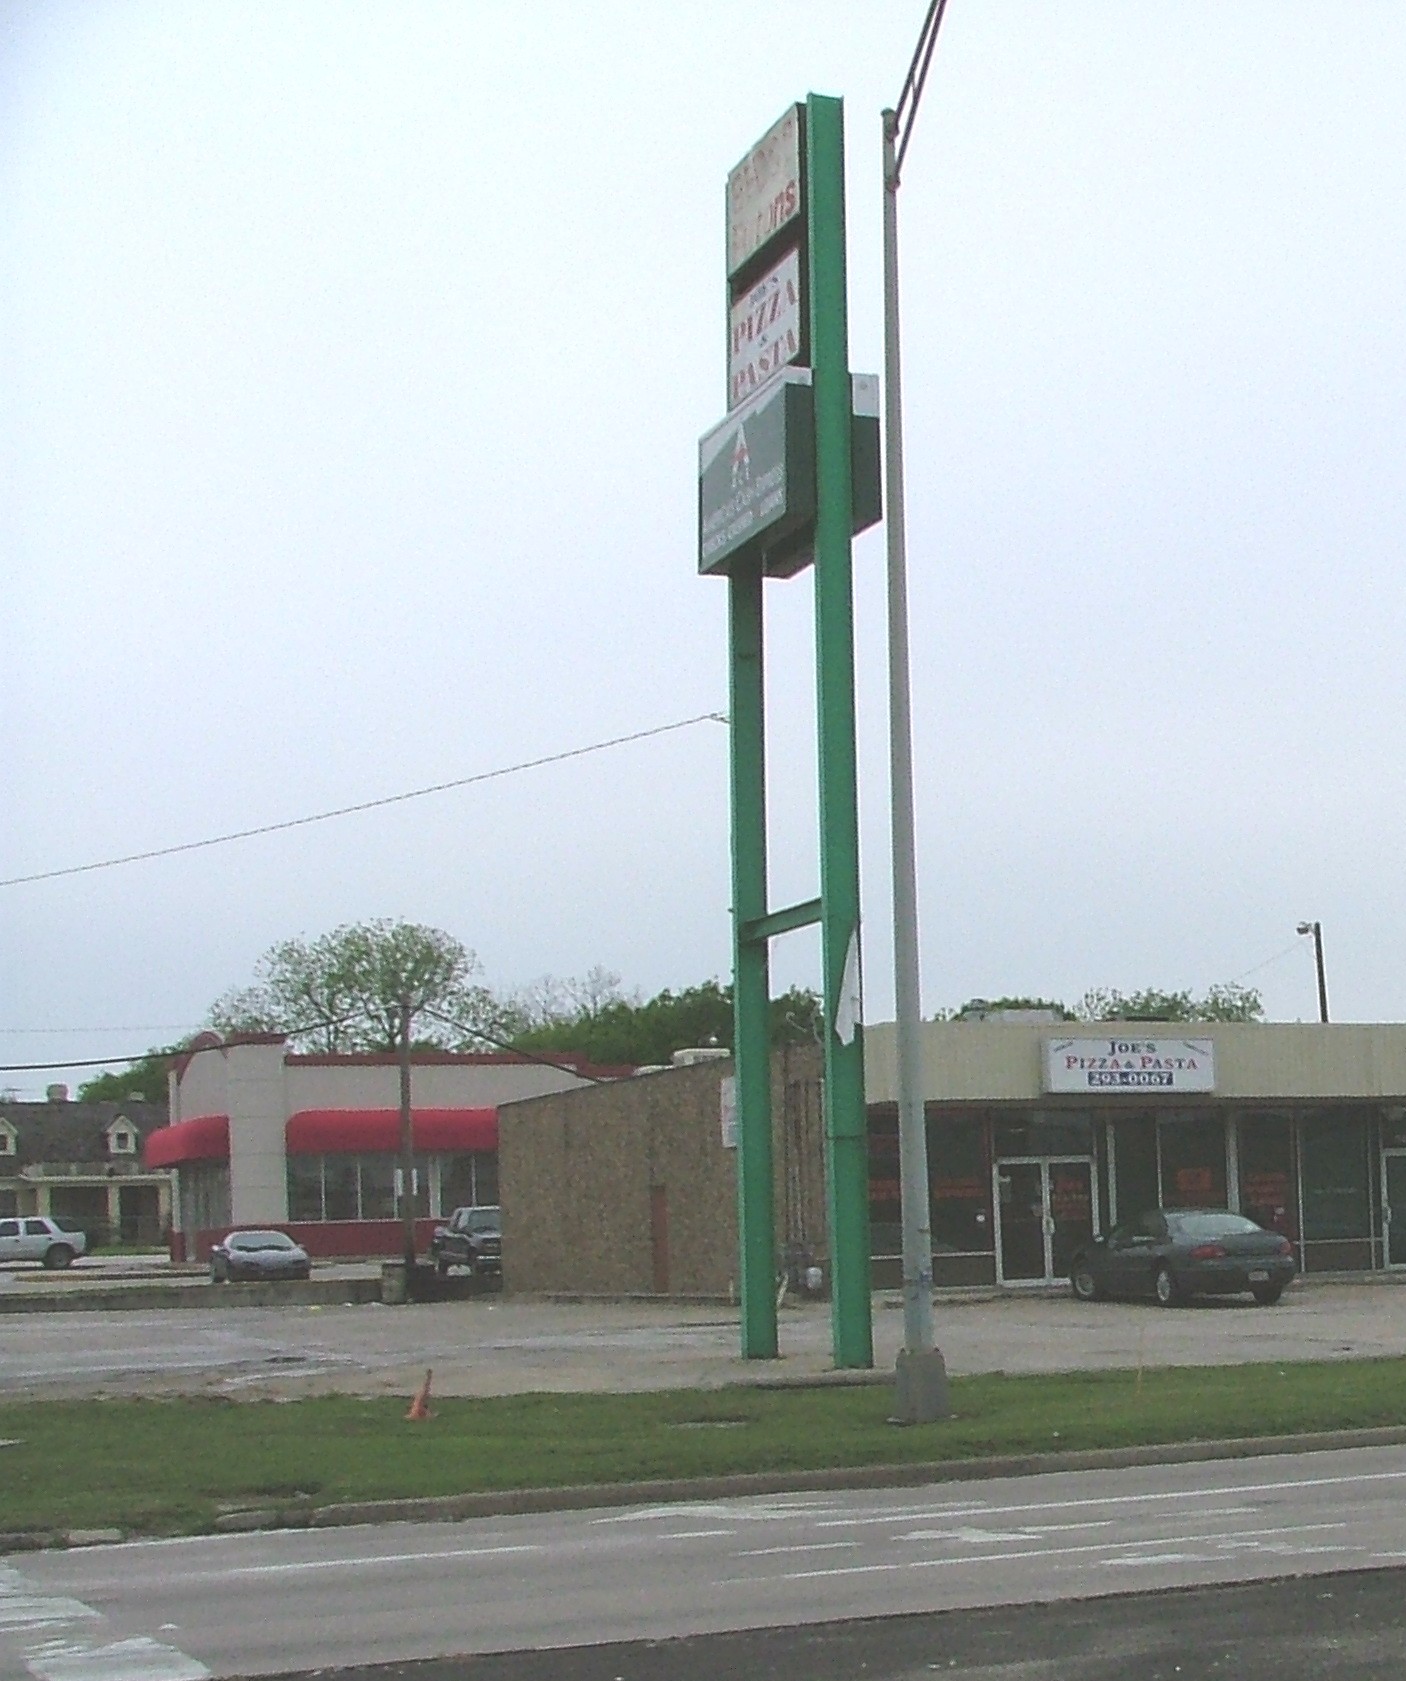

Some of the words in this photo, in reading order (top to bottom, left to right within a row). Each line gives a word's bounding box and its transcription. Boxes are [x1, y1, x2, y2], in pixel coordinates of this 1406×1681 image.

[733, 278, 798, 355] PIZZA
[732, 328, 798, 400] PASTA
[1065, 1055, 1122, 1070] PIZZA
[1140, 1054, 1199, 1071] PASTA
[1108, 1040, 1157, 1056] JOE'S
